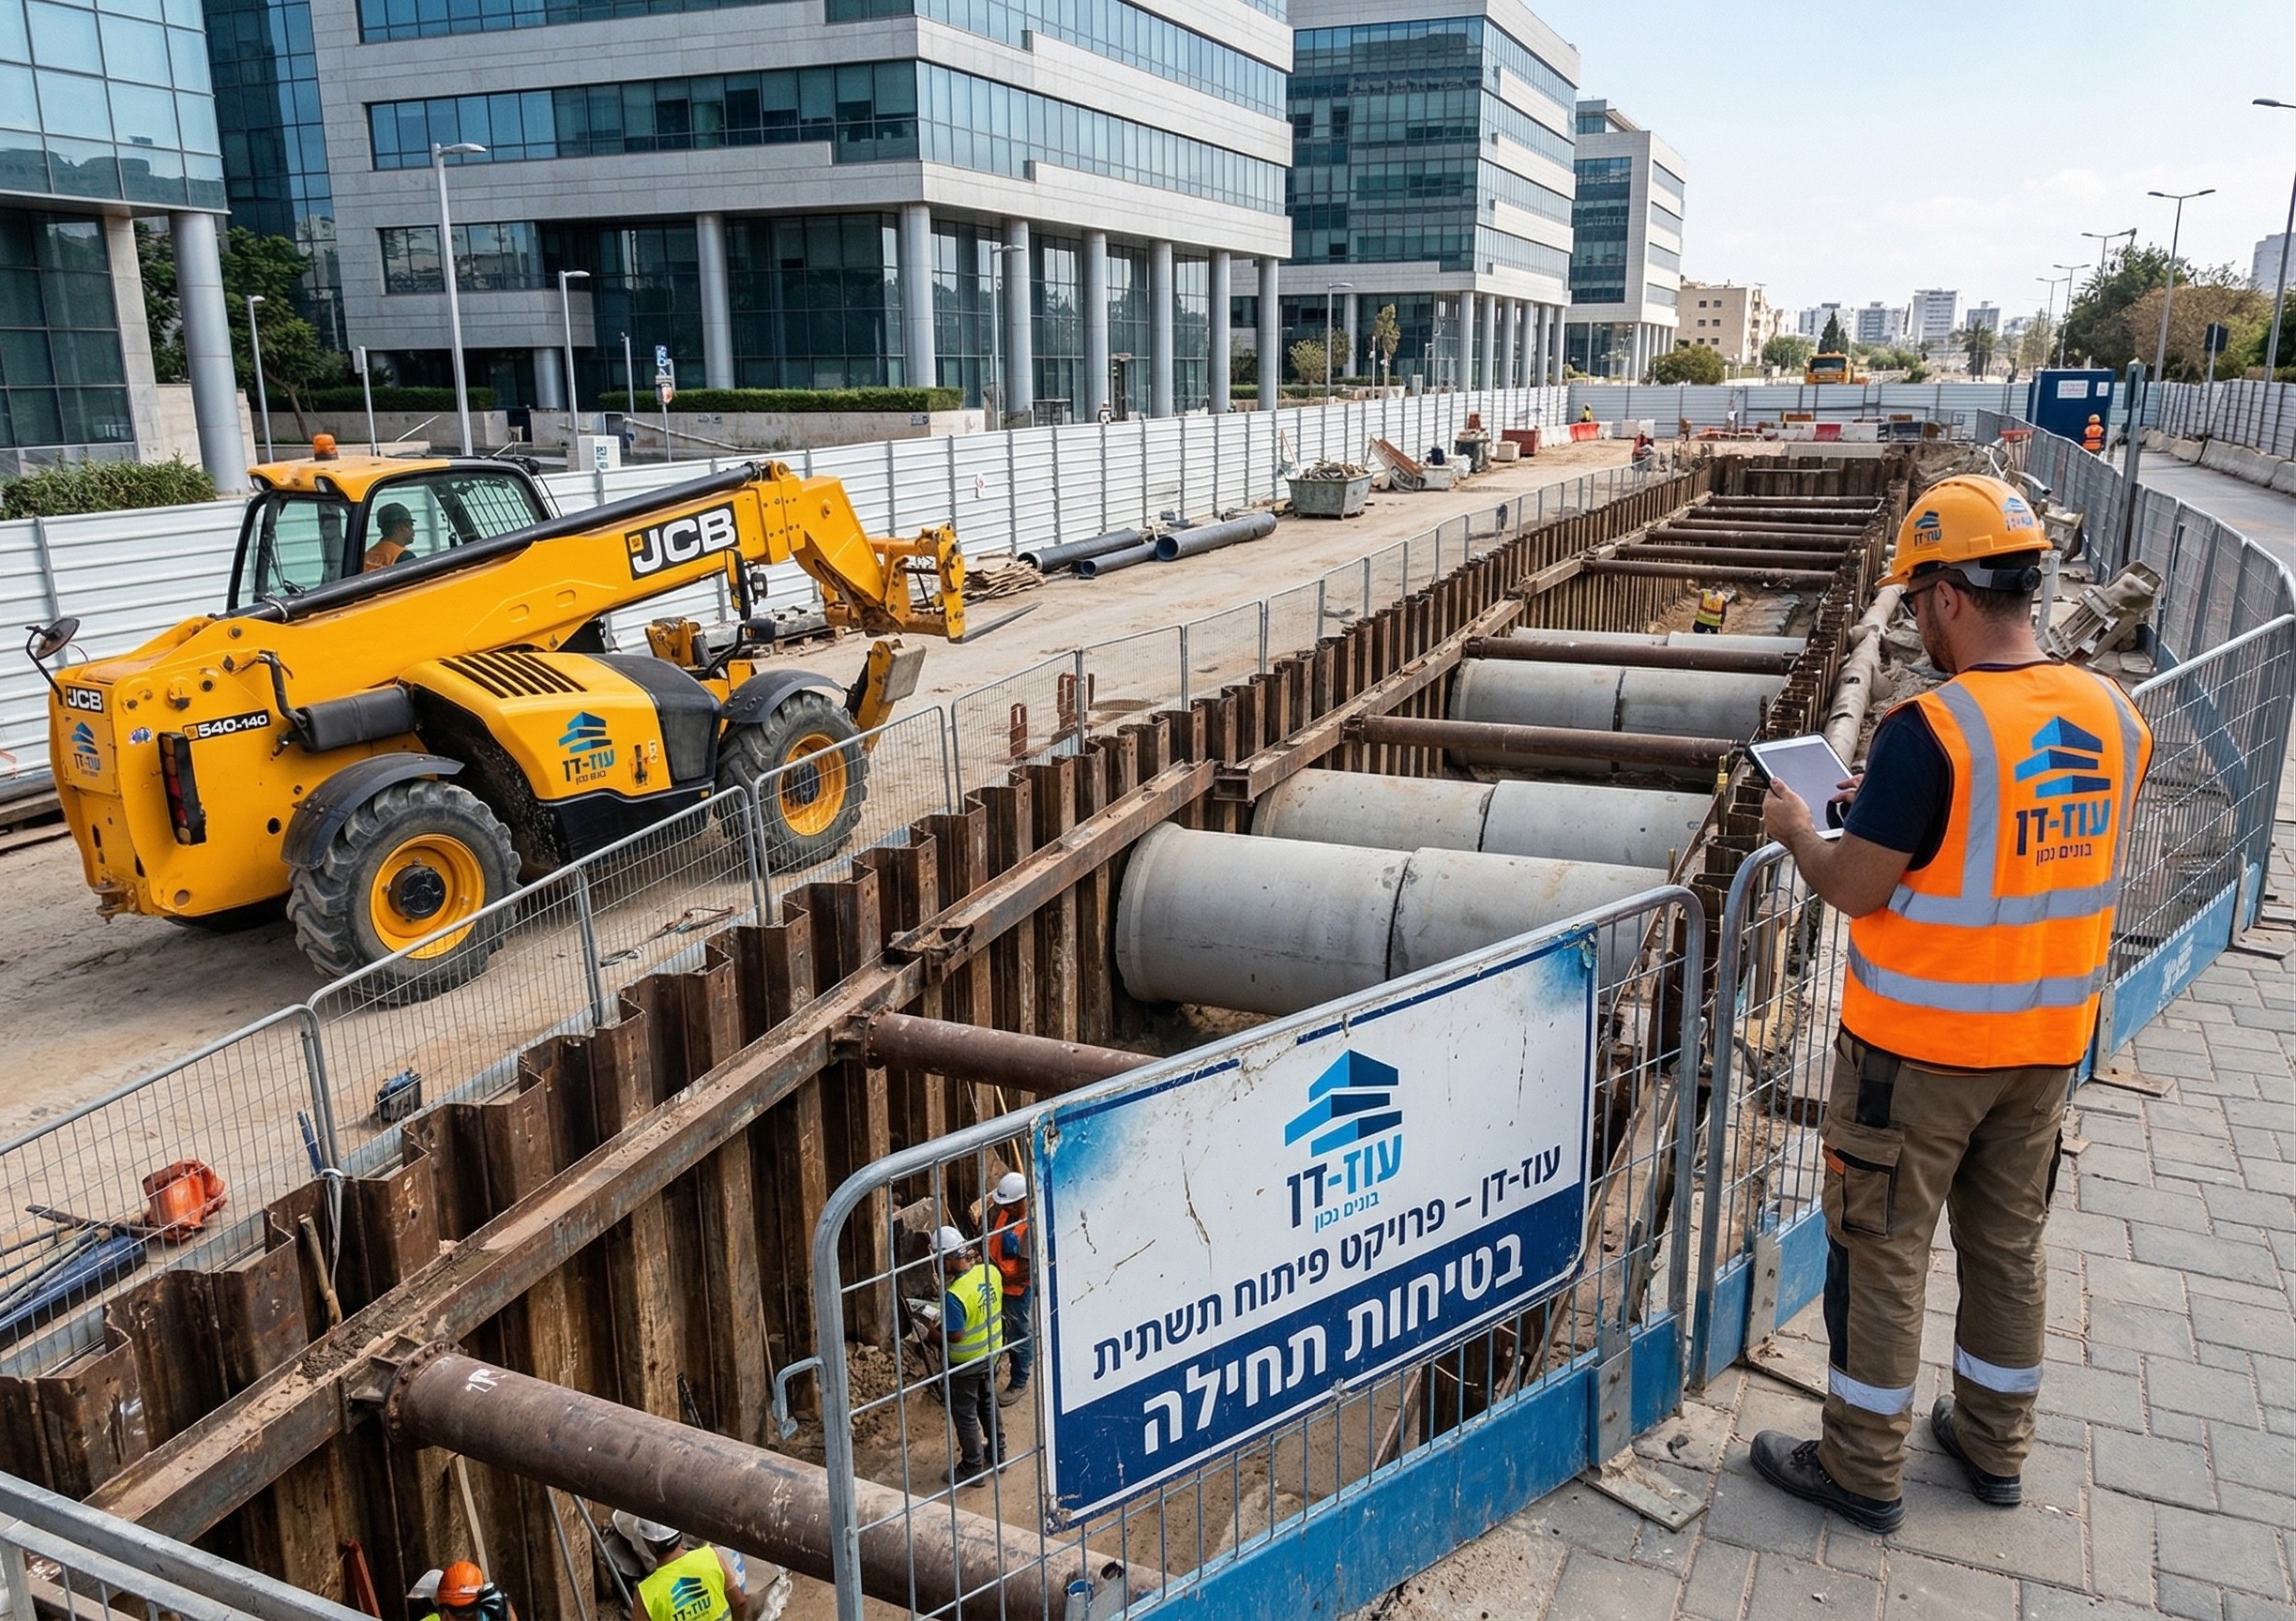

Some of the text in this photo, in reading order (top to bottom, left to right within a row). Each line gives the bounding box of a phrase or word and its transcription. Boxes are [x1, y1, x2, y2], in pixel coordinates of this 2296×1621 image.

[632, 508, 735, 573] JCB
[68, 688, 102, 710] JCB
[198, 714, 268, 737] 540-140
[563, 750, 614, 782] עוז-דן
[2016, 799, 2110, 856] עוז-דן
[2036, 843, 2092, 867] בונים נכון
[1287, 1133, 1402, 1229] עוז-דן
[1314, 1190, 1380, 1234] בונים נכון
[1480, 1144, 1561, 1219] עוז-דן
[1340, 1198, 1445, 1272] פרויקט
[1234, 1248, 1330, 1317] פיתוח
[1094, 1293, 1222, 1380] תשתית
[1143, 1234, 1523, 1456] בטיחות תחילה
